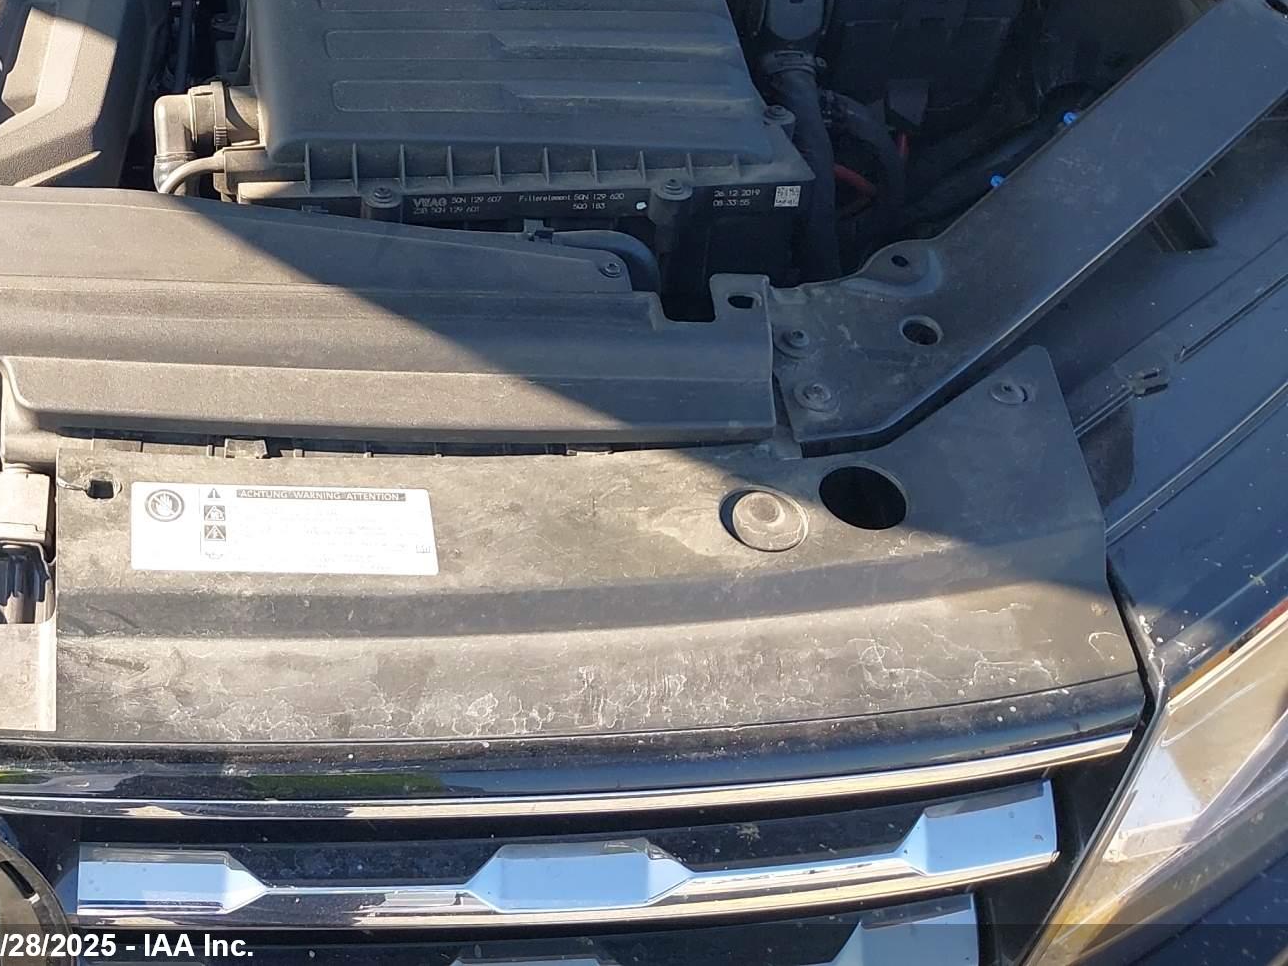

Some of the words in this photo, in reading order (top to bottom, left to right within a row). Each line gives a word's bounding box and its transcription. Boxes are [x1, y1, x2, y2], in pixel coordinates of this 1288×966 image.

[240, 490, 288, 499] ACHTUNG
[293, 491, 342, 500] WARNING
[346, 492, 399, 501] ATTENTION
